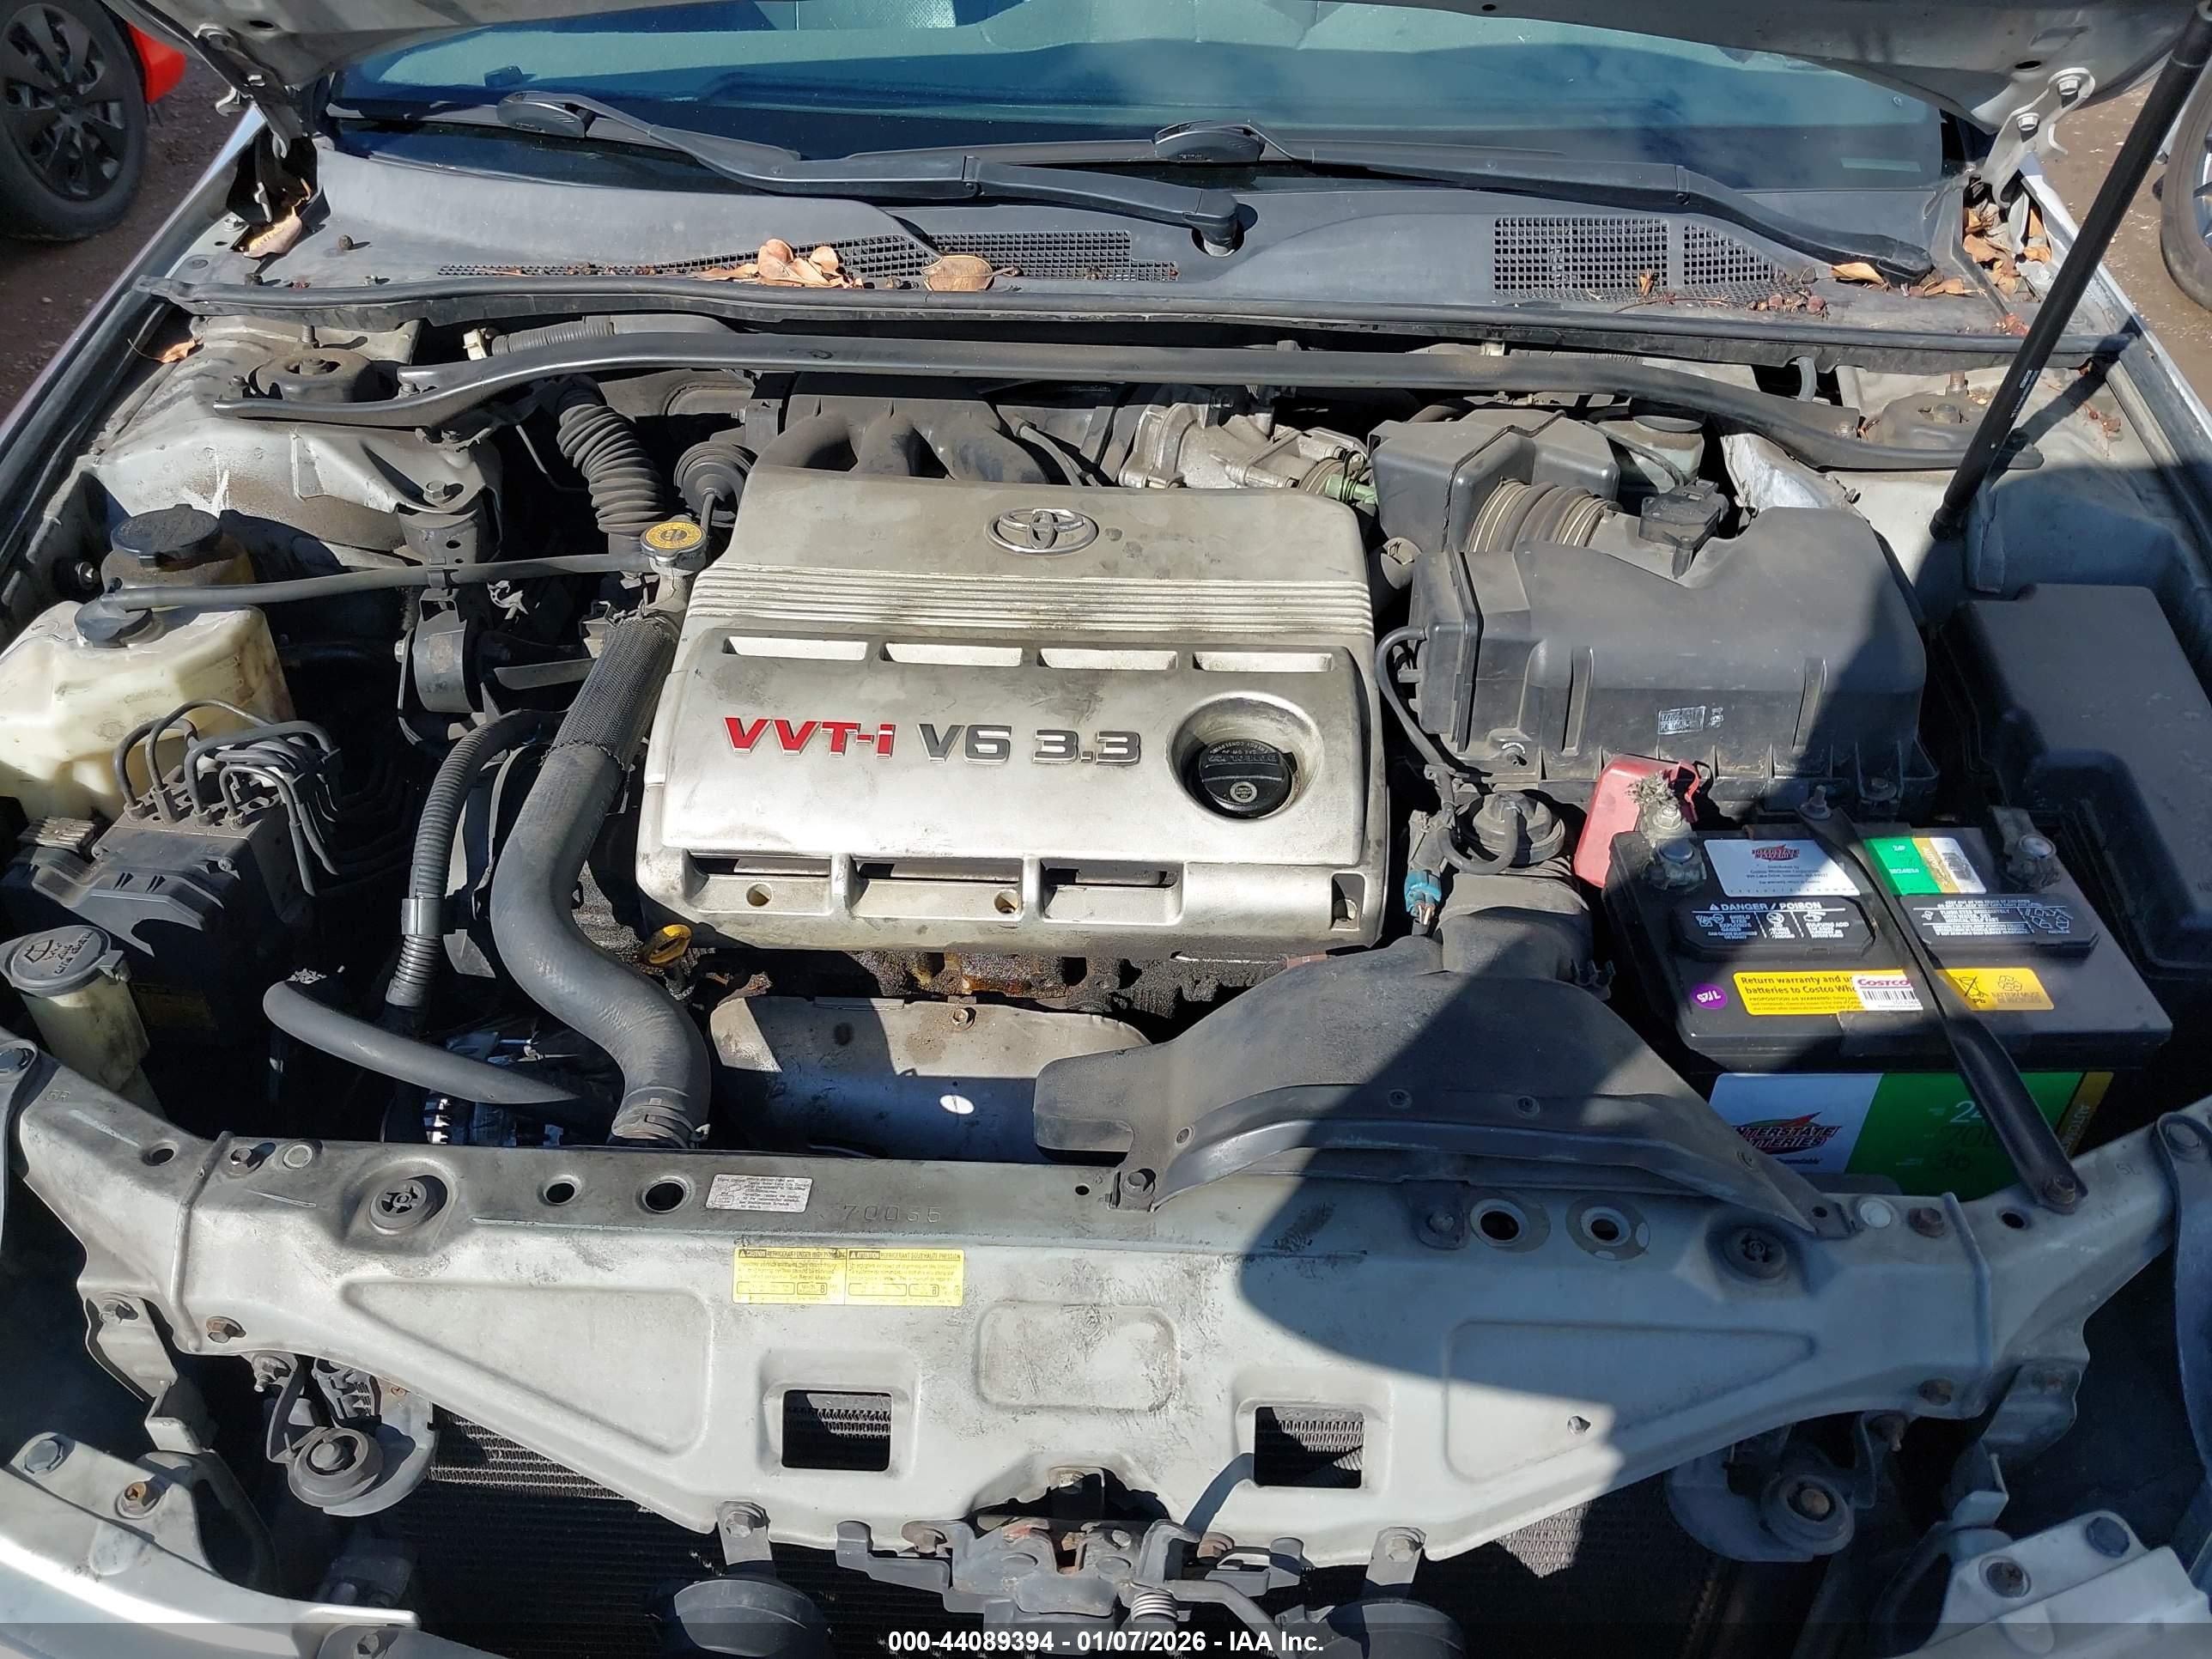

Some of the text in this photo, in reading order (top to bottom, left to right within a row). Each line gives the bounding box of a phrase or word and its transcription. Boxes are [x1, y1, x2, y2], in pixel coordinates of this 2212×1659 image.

[724, 717, 1141, 765] VVT-i V6 3.3
[1741, 976, 1775, 985] Return
[1777, 976, 1820, 987] warranty
[1824, 975, 1844, 984] and
[1745, 986, 1789, 994] batteries
[1731, 1126, 1840, 1138] NTERSTATE
